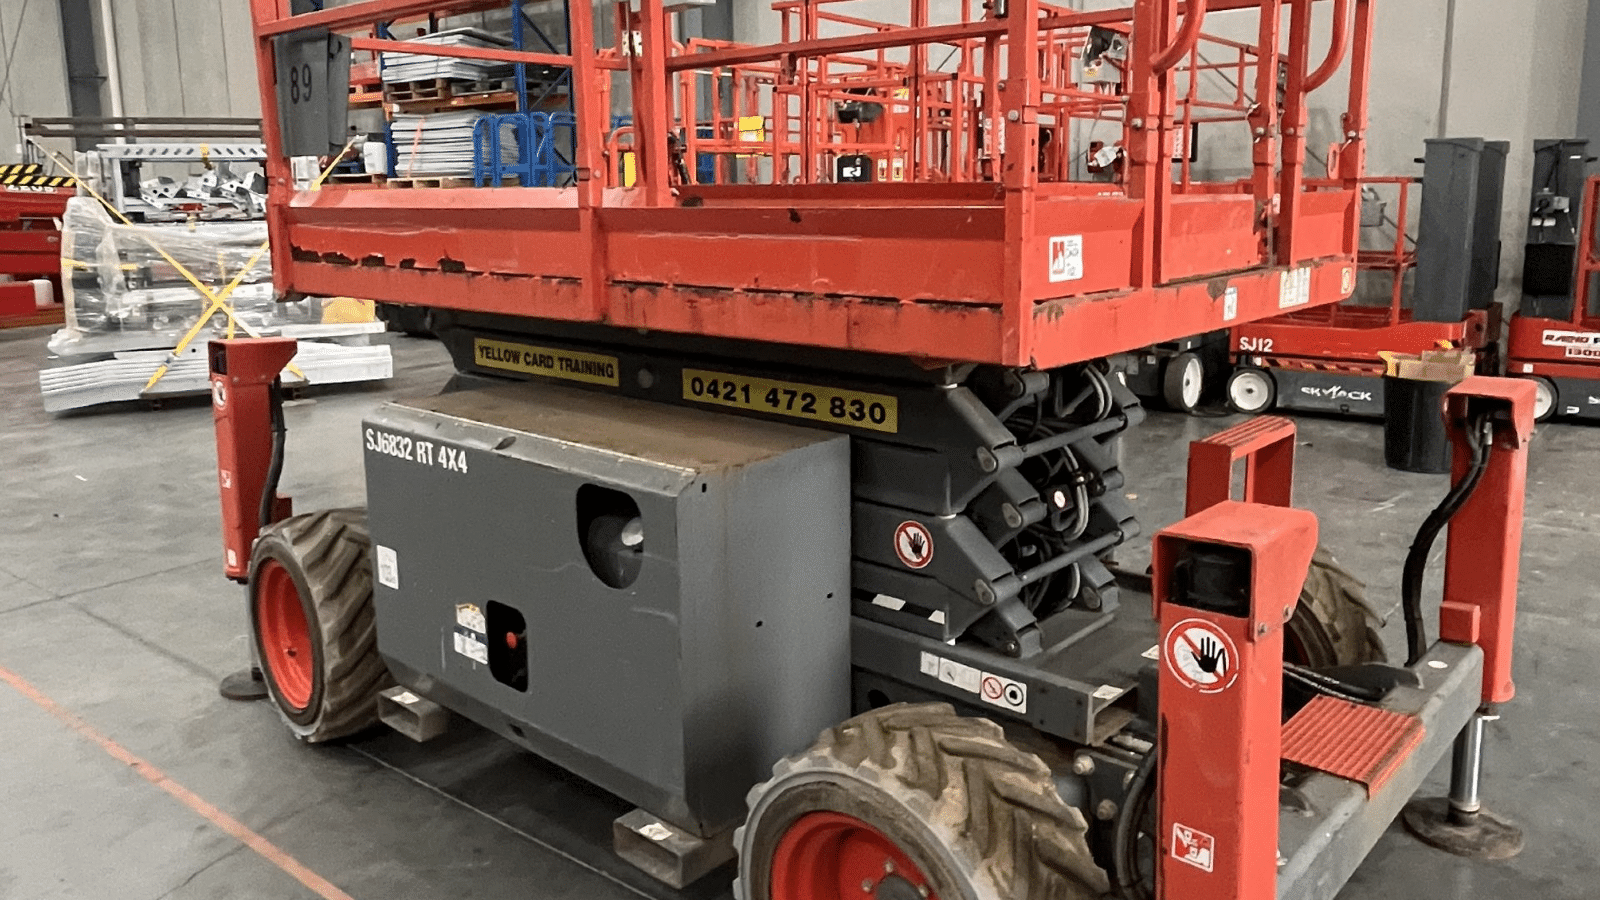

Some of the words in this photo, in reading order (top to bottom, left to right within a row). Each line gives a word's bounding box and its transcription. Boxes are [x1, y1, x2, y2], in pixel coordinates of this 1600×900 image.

[291, 63, 312, 104] 89
[479, 345, 520, 365] YELLOW
[523, 351, 555, 370] CARD
[557, 356, 615, 379] TRAINING
[1239, 336, 1273, 352] SJ12
[691, 376, 751, 404] 0421
[764, 387, 817, 415] 472
[829, 396, 886, 425] 830
[1301, 385, 1372, 402] SKYJACK
[366, 428, 414, 461] SJ6832
[416, 441, 435, 466] RT
[438, 446, 469, 474] 4X4
